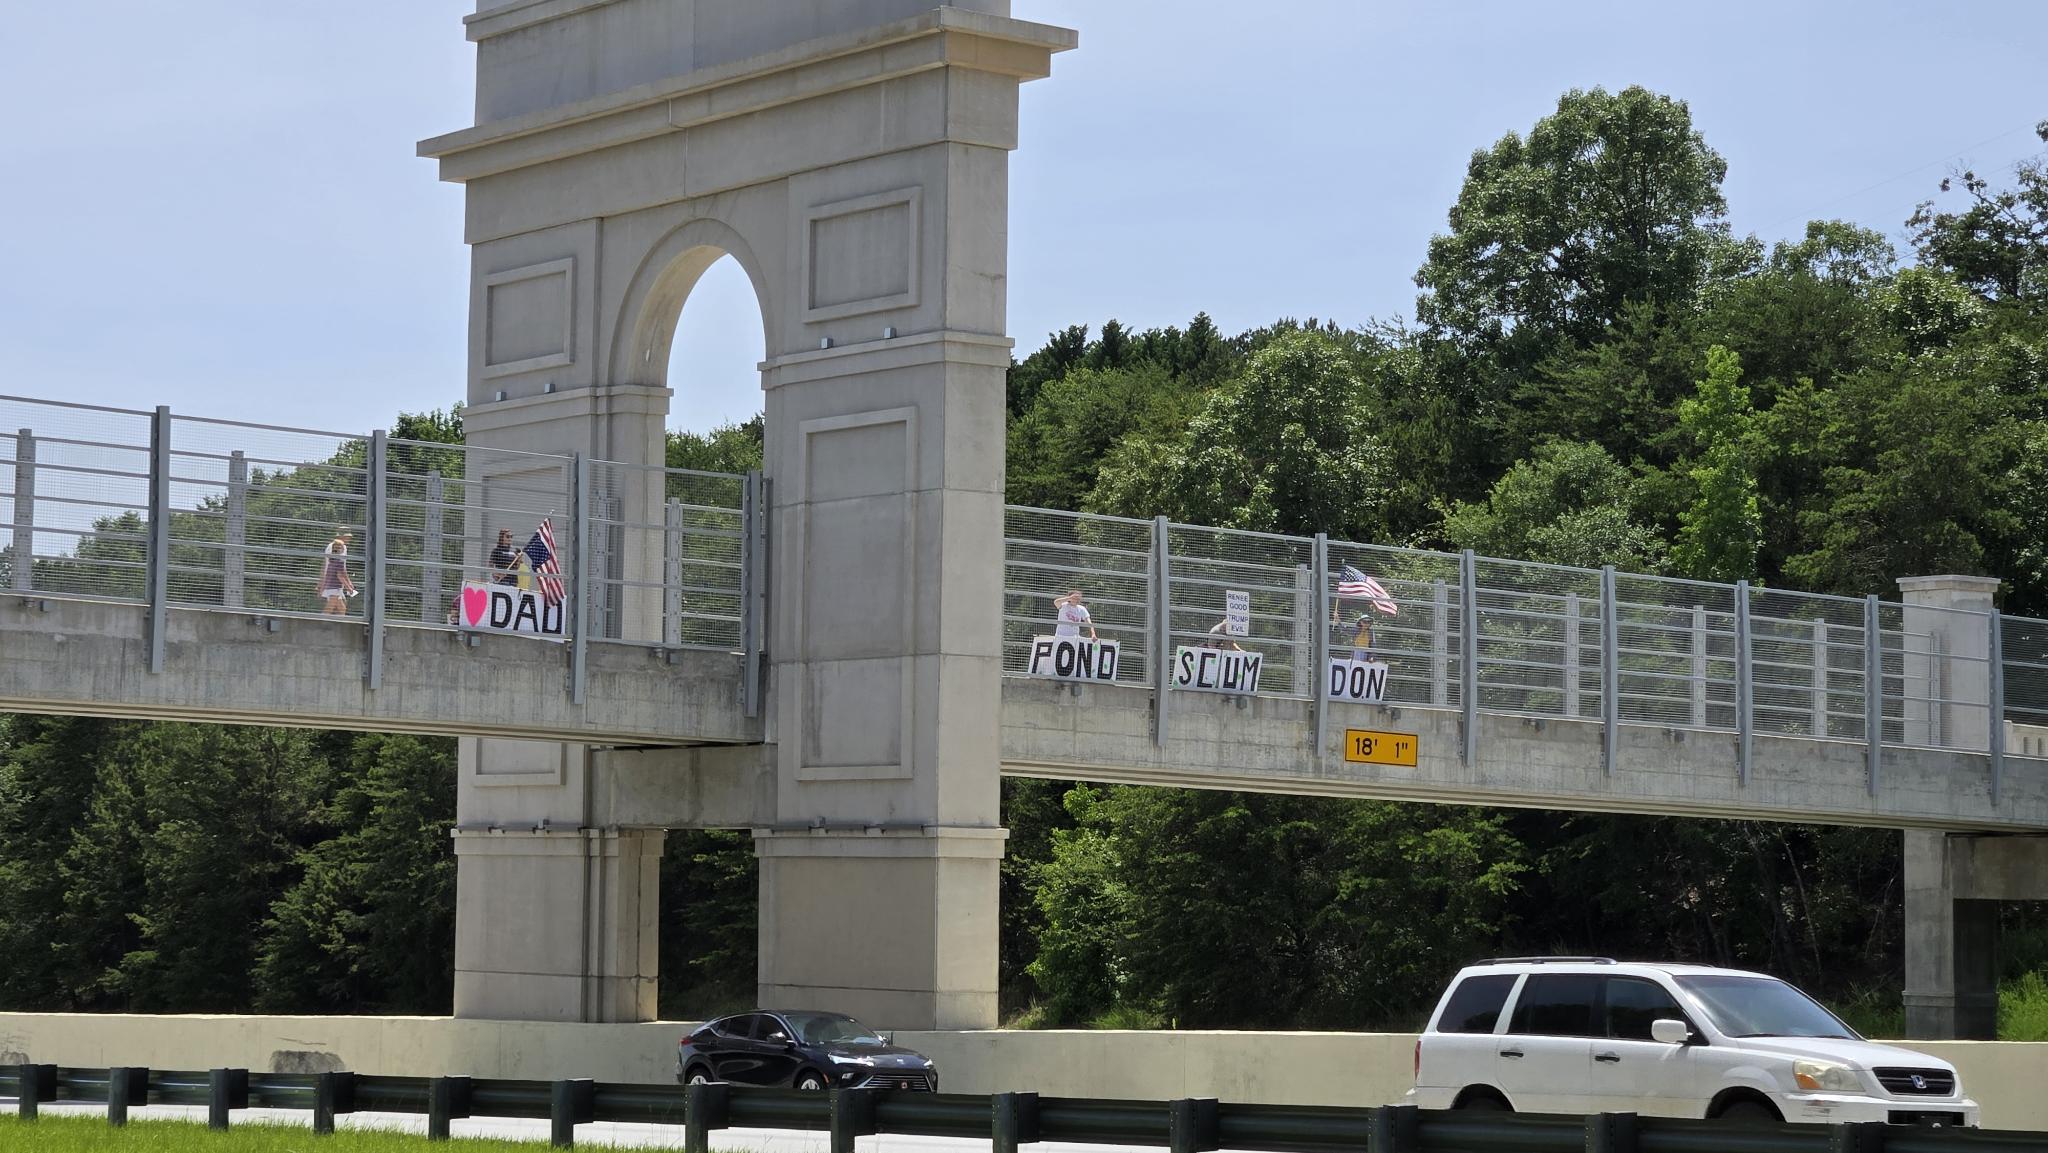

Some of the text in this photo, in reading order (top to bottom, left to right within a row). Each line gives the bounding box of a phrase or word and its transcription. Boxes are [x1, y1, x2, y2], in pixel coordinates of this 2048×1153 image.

[1227, 593, 1249, 602] RENEE
[1229, 602, 1248, 611] GOOD
[490, 591, 562, 634] DAD
[1227, 614, 1249, 623] TRUMP
[1231, 624, 1245, 633] EVIL
[1032, 641, 1116, 680] POND
[1178, 651, 1261, 692] SCUM
[1330, 664, 1385, 700] DON
[1355, 737, 1378, 756] 18'
